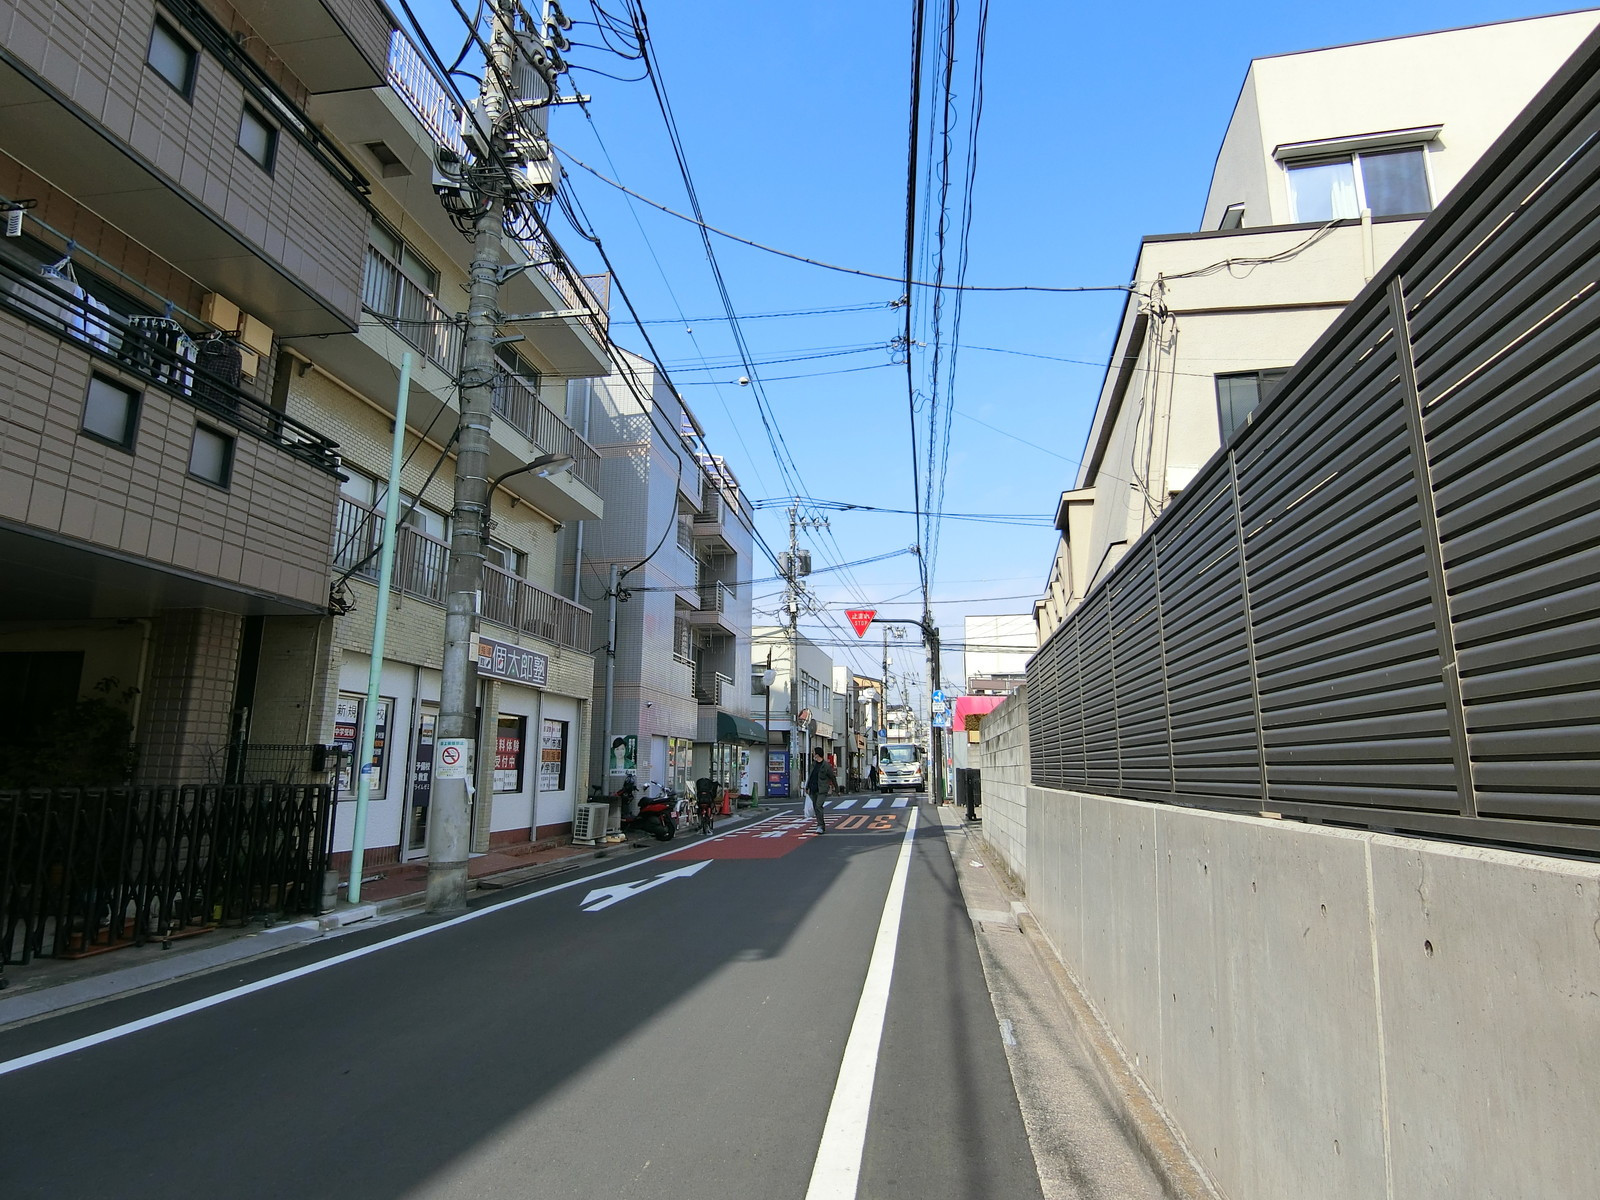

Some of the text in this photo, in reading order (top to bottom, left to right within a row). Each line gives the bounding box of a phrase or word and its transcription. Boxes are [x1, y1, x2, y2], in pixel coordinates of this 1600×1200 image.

[492, 644, 545, 684] 個太郎塾
[337, 704, 357, 718] 新規
[494, 755, 516, 768] 受付中
